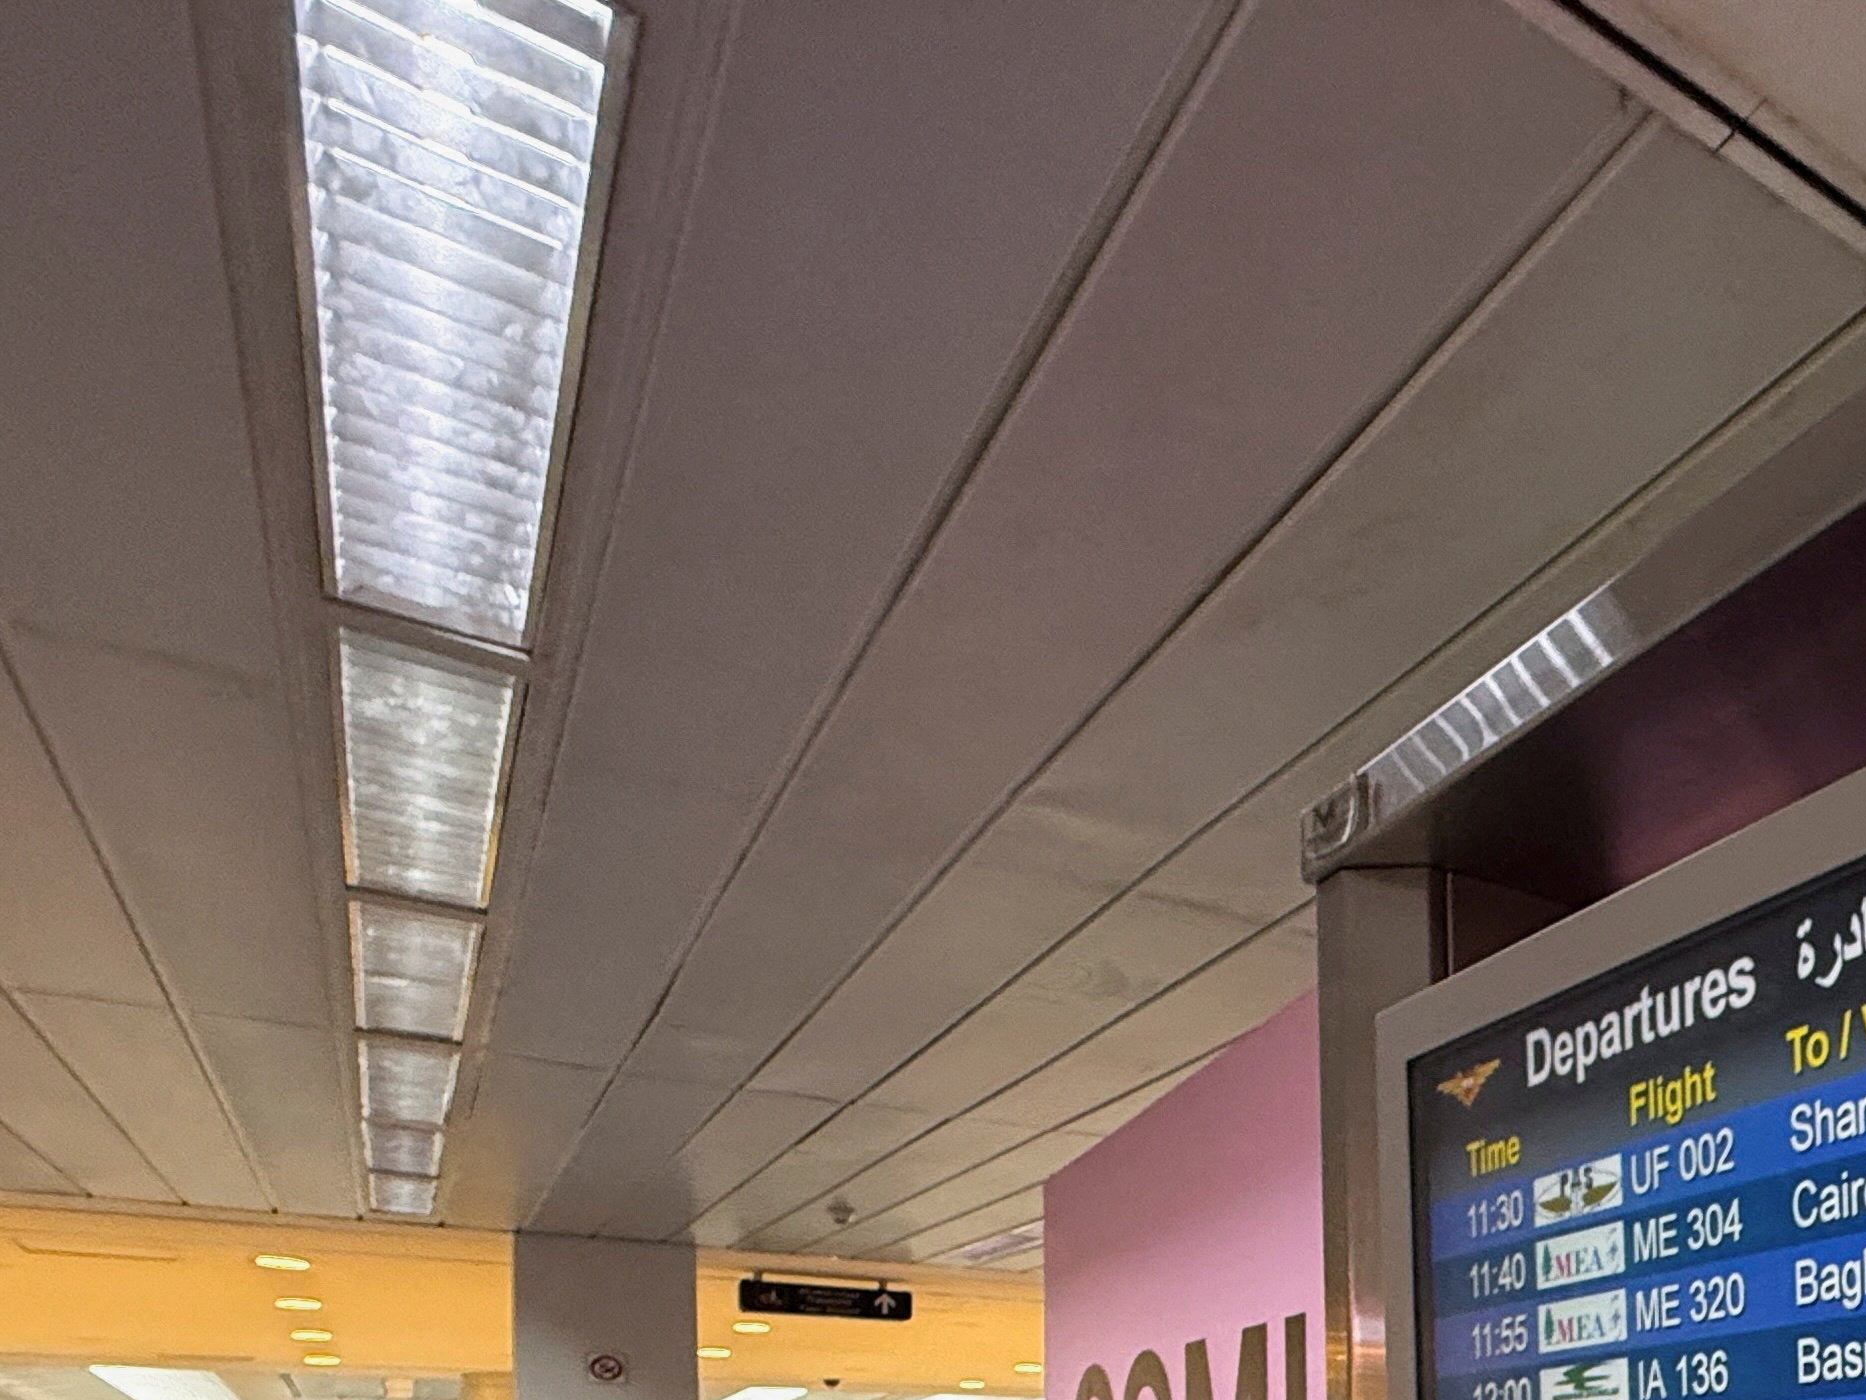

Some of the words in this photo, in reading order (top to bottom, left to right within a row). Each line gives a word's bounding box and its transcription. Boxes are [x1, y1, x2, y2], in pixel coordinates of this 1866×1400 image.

[1526, 957, 1755, 1087] Departures
[1786, 1025, 1828, 1073] To
[1840, 1010, 1851, 1059] /
[1630, 1062, 1716, 1126] Flight
[1466, 1137, 1520, 1176] Time
[1631, 1145, 1669, 1194] UF
[1680, 1128, 1734, 1180] 002
[1468, 1190, 1523, 1237] 11:30
[1634, 1214, 1678, 1262] ME
[1687, 1199, 1742, 1249] 304
[1470, 1253, 1526, 1298] 11:40
[1636, 1284, 1681, 1330] ME
[1690, 1273, 1744, 1321] 320
[1472, 1315, 1528, 1359] 11:55
[1639, 1359, 1666, 1400] IA
[1676, 1350, 1728, 1395] 136
